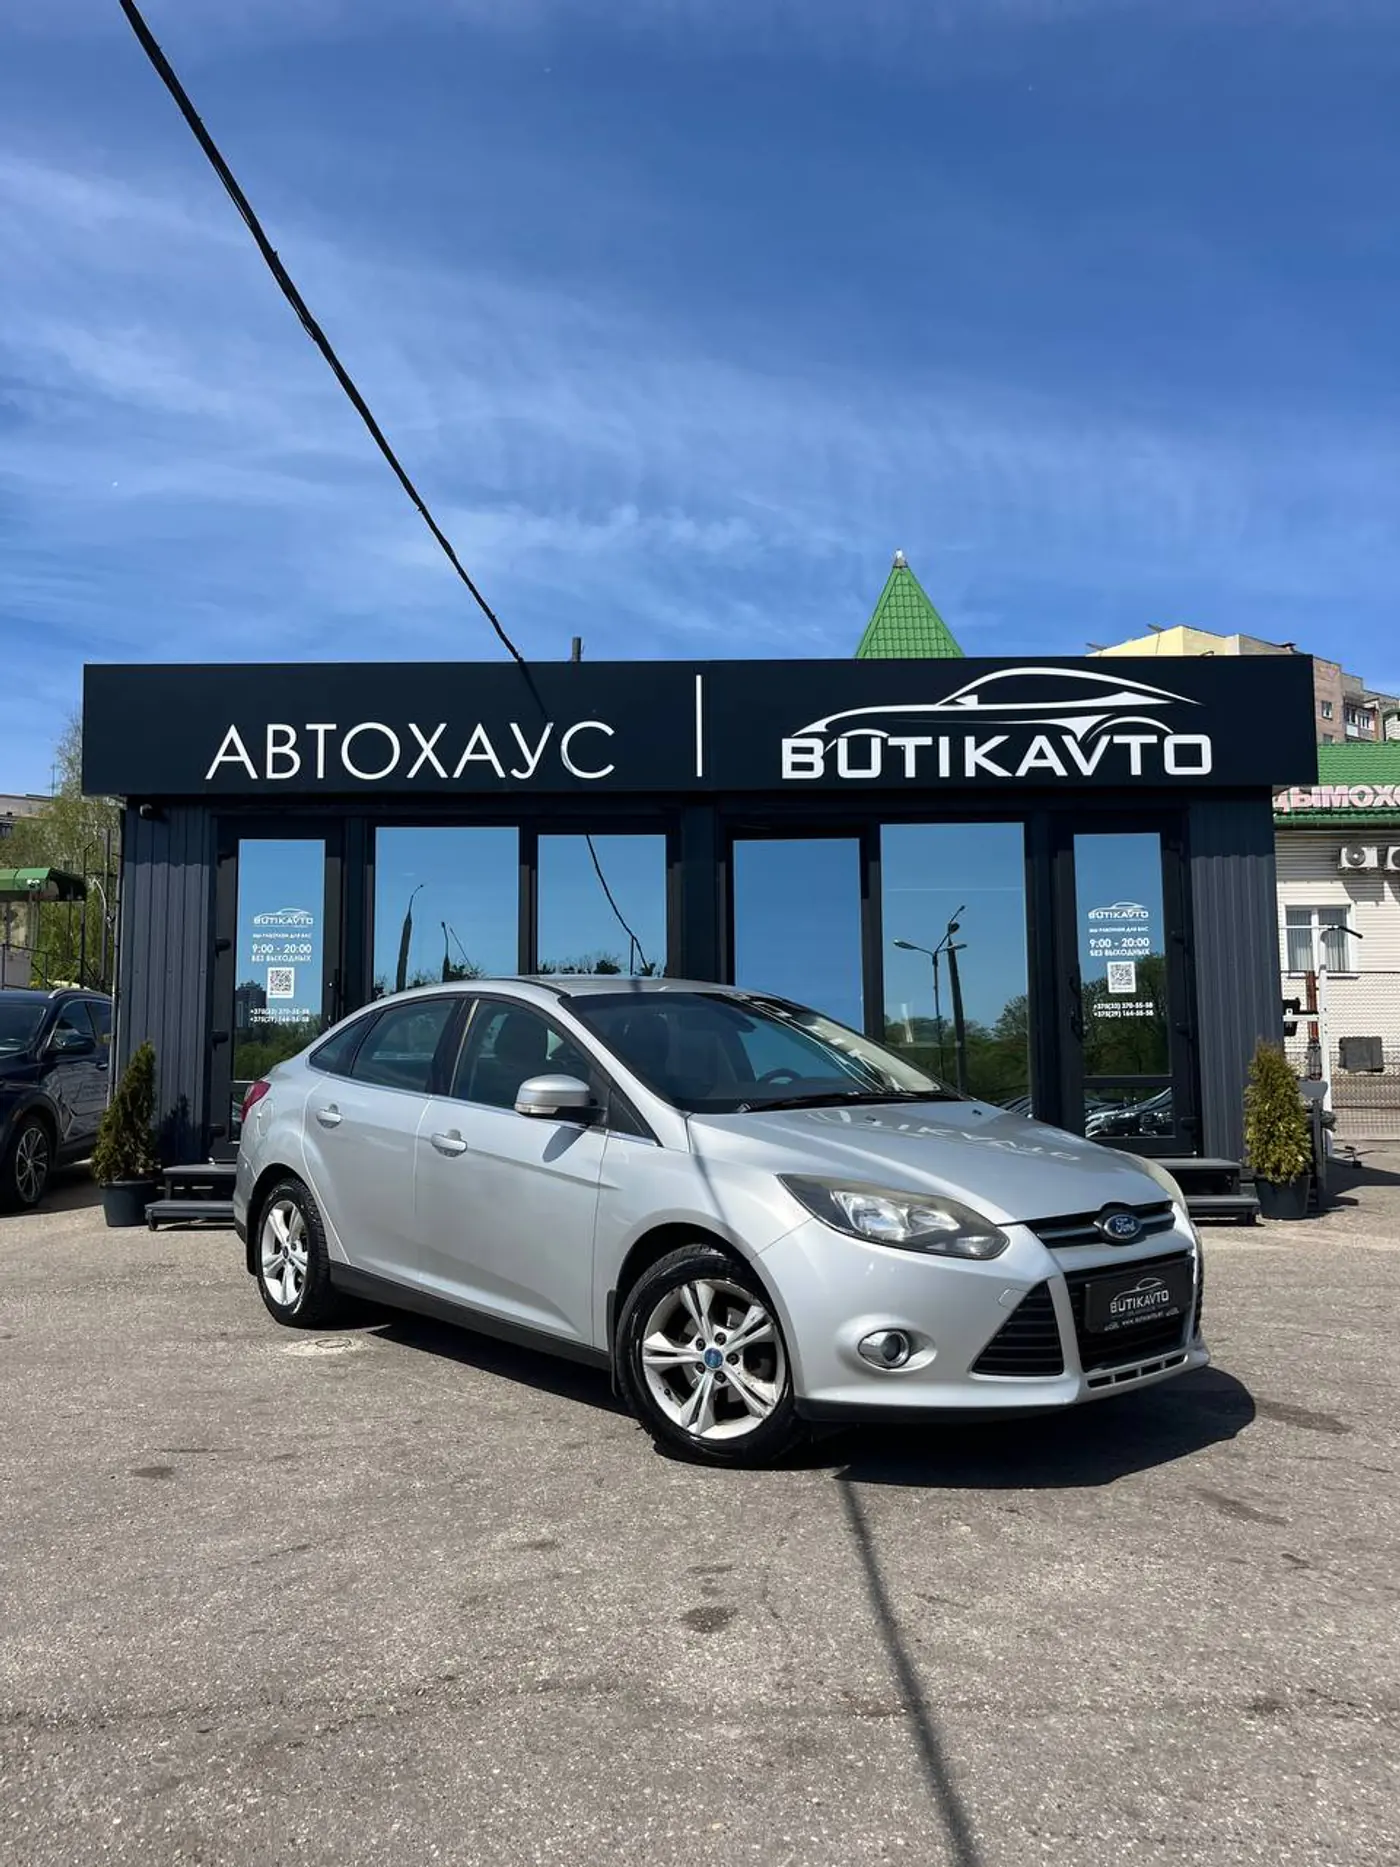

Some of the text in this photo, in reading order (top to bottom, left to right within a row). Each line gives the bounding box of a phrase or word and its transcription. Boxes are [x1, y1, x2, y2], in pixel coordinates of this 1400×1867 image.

[205, 720, 616, 780] АВТОХАУС
[781, 733, 1213, 780] BUTIKAVTO
[252, 944, 274, 954] 9:00
[283, 944, 312, 954] 20:00
[1089, 939, 1111, 948] 9:00
[1121, 938, 1150, 947] 20:00
[1110, 1290, 1169, 1313] BUTIKAVTO
